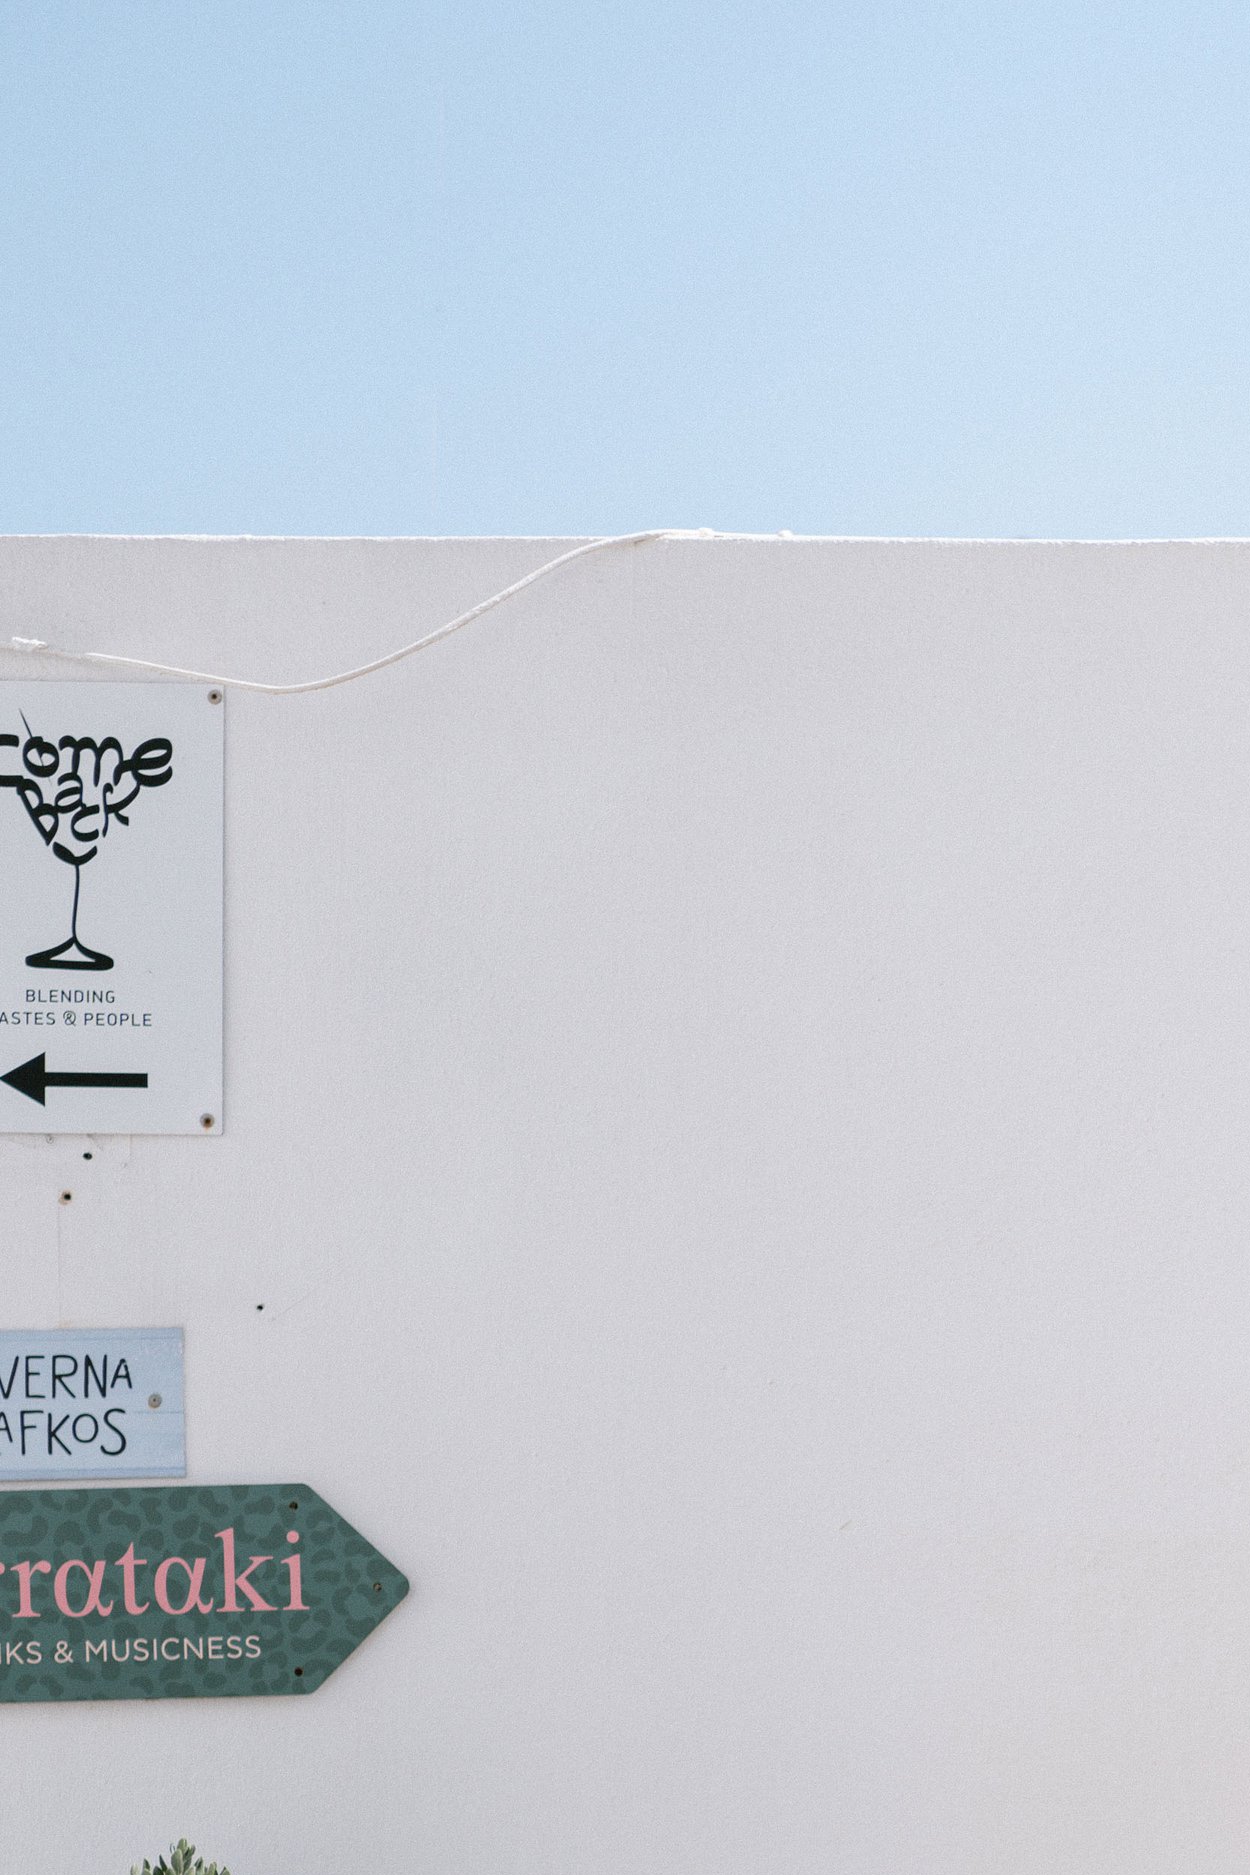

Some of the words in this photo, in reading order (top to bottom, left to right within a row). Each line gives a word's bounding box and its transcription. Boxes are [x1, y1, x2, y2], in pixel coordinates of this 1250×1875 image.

[25, 989, 116, 1004] BLENDING
[0, 1011, 56, 1026] ASTES
[83, 1012, 153, 1027] PEOPLE
[0, 1354, 133, 1399] VERNA
[0, 1528, 310, 1618] rataki
[0, 1641, 42, 1665] KS
[54, 1640, 74, 1663] &
[85, 1635, 262, 1663] MUSICNESS
